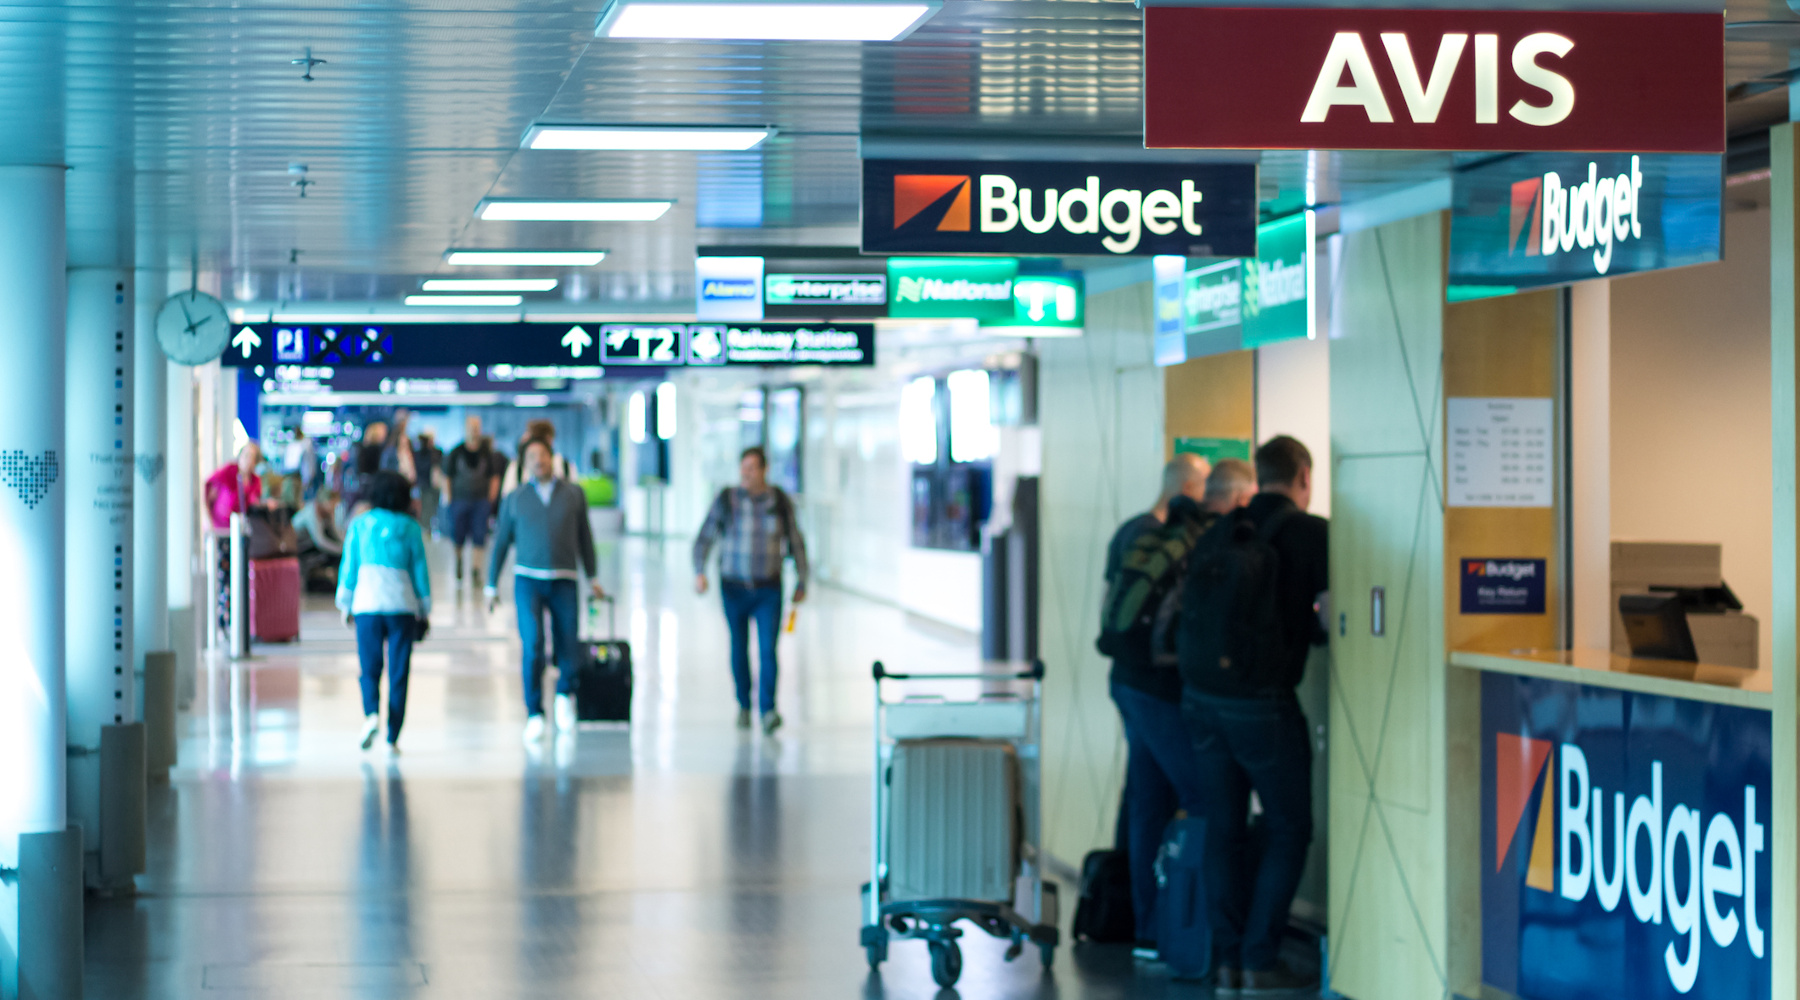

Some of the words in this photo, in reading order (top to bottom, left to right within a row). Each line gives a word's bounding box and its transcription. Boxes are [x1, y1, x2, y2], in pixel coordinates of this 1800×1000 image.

[1301, 31, 1574, 126] AVIS
[980, 175, 1203, 254] Budget
[1542, 154, 1642, 275] Budget
[771, 280, 883, 301] enterprise
[923, 279, 1011, 301] National
[632, 327, 676, 361] T2
[727, 328, 795, 352] Railway
[795, 327, 858, 349] Station
[1484, 562, 1535, 581] Budget
[1561, 743, 1764, 993] Budget
